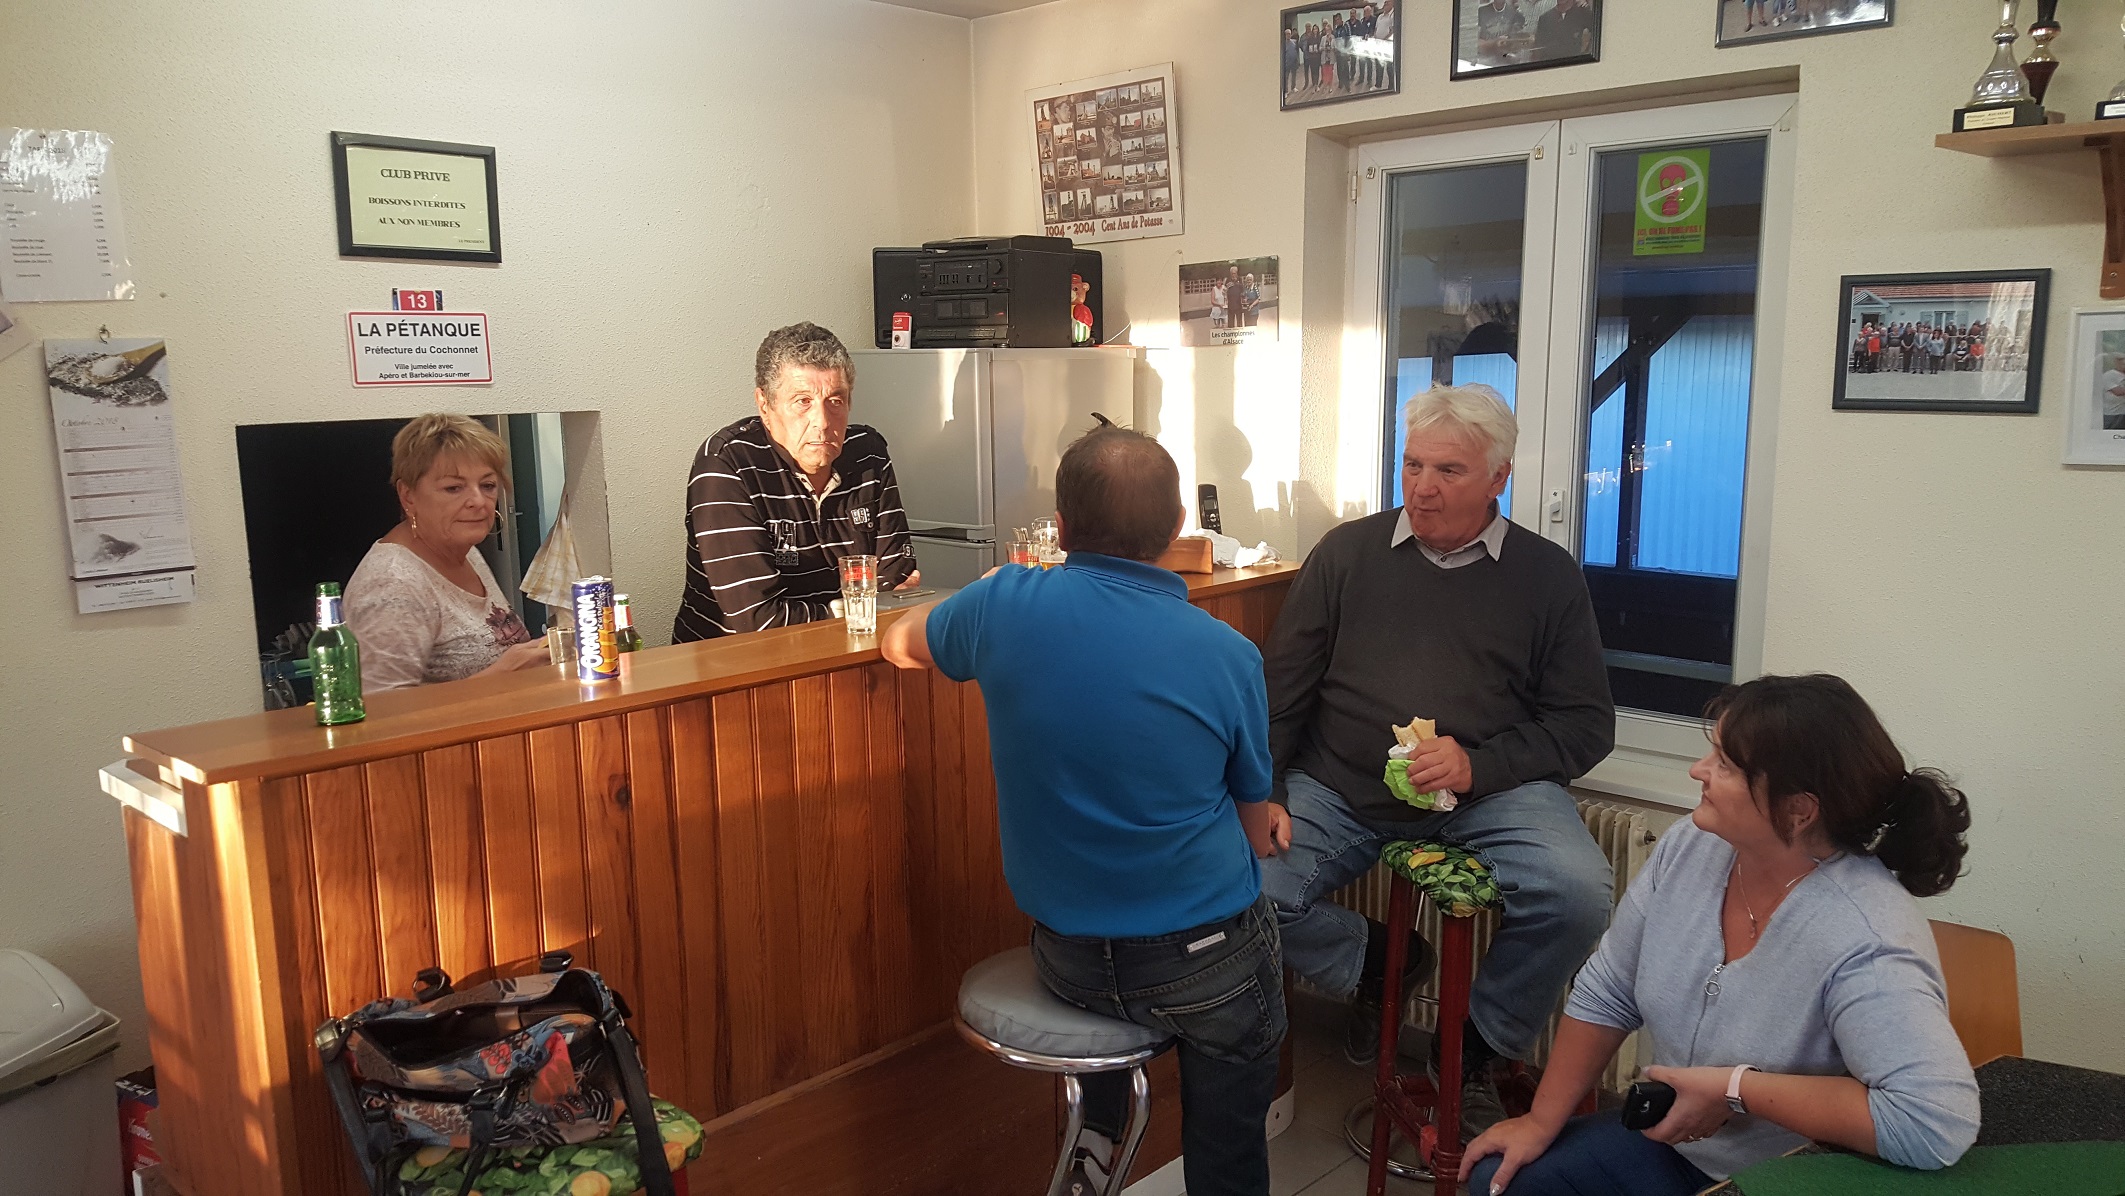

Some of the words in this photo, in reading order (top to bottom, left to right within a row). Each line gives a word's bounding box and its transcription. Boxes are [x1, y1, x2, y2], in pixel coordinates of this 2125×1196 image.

[381, 168, 411, 179] CLUB
[413, 170, 450, 182] PRIVE
[368, 196, 411, 206] BOISSONS
[413, 199, 466, 209] INTERDITES
[378, 217, 395, 225] AUX
[397, 218, 415, 226] NON
[416, 219, 461, 228] MEMBRES
[1073, 221, 1096, 236] 2004
[1101, 219, 1117, 232] Cent
[1117, 217, 1130, 231] Ans
[1130, 215, 1139, 229] de
[1140, 214, 1163, 228] Potasse
[407, 294, 427, 308] 13
[357, 322, 382, 337] LA
[386, 319, 481, 337] PÉTANQUE
[1211, 331, 1221, 339] Les
[364, 346, 413, 355] Préfecture
[415, 346, 427, 354] du
[429, 345, 479, 354] Cochonnet
[410, 363, 437, 371] jumelée
